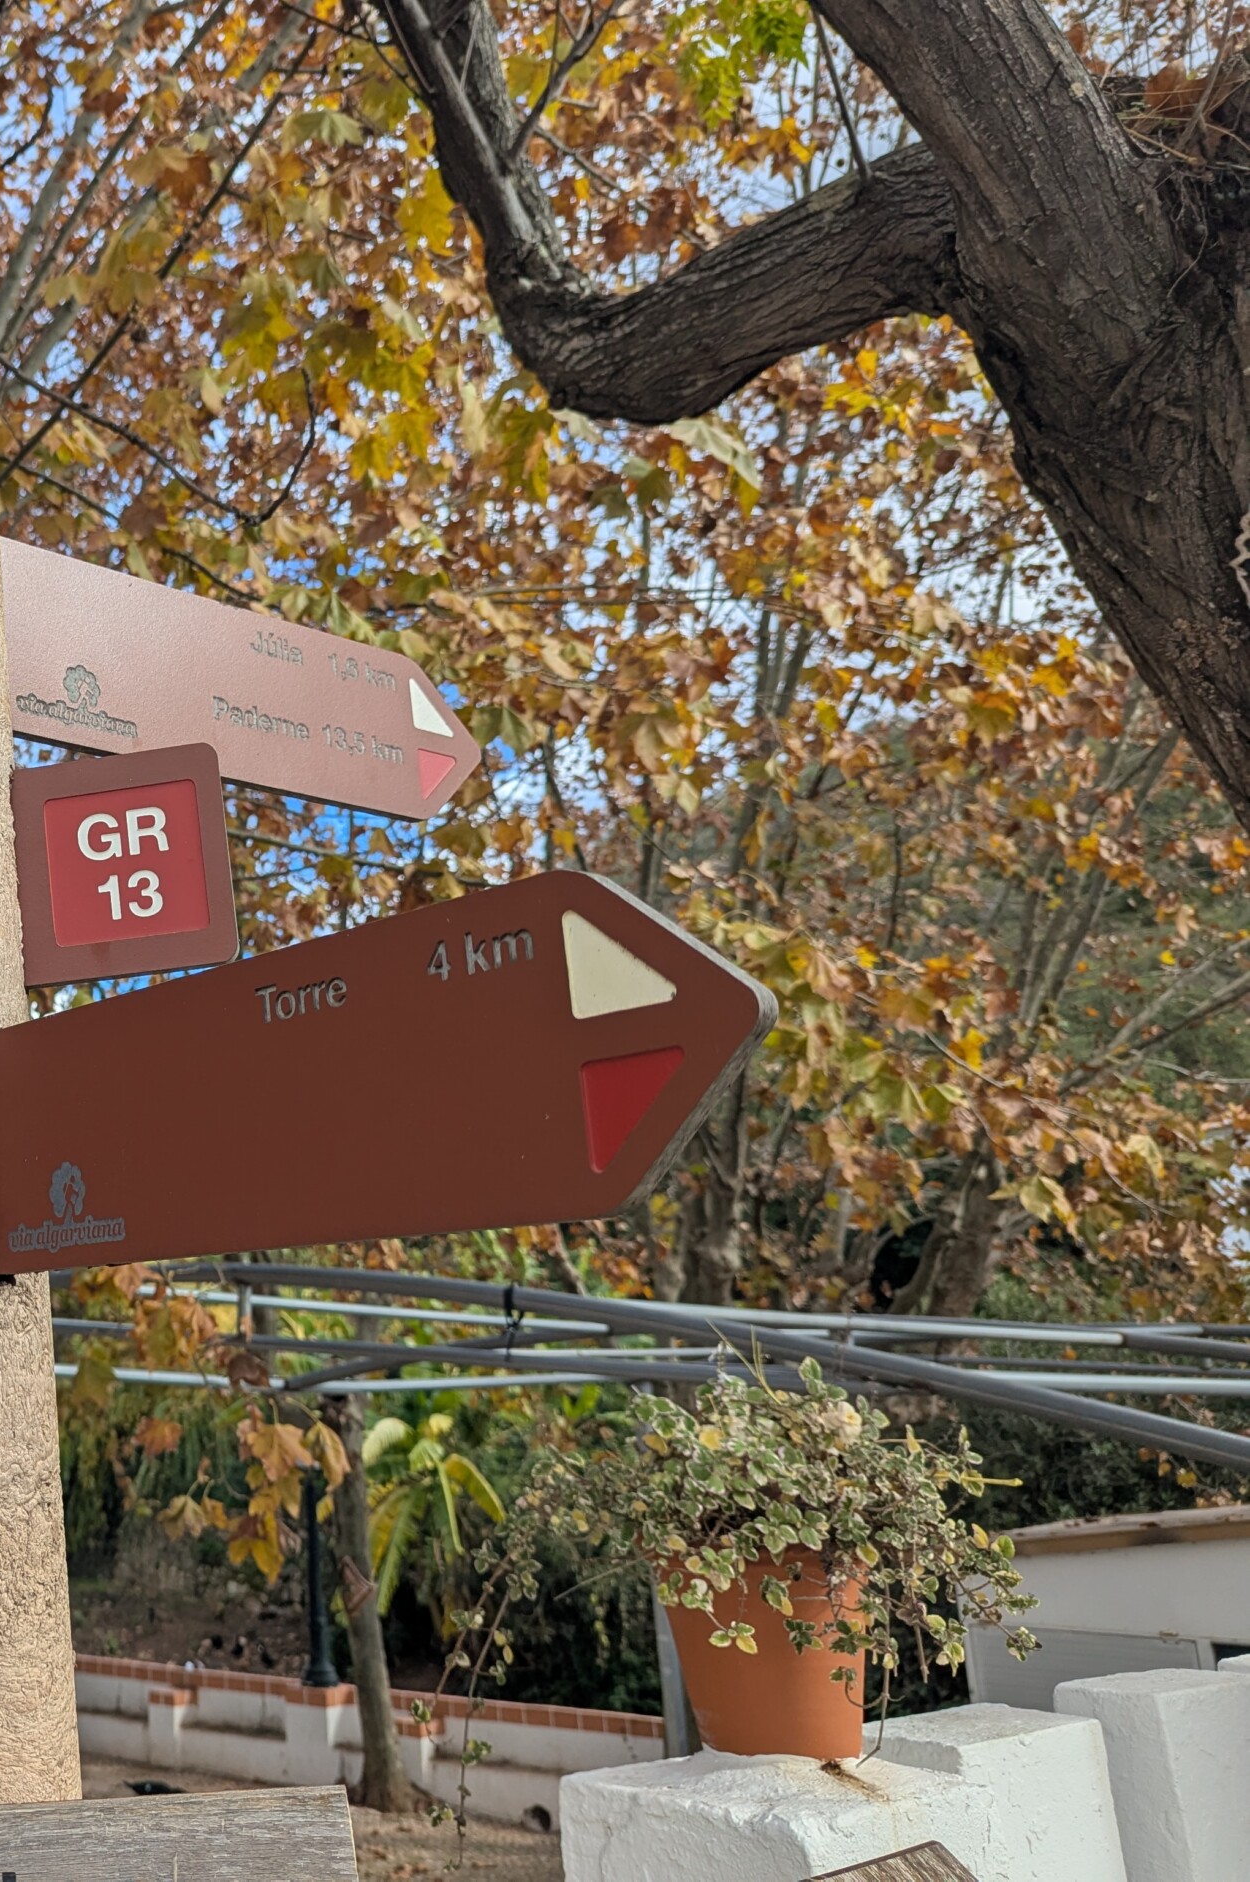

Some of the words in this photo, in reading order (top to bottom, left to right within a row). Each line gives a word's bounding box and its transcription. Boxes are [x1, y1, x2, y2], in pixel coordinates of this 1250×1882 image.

[365, 661, 396, 691] km
[213, 696, 310, 742] Paderne
[322, 723, 366, 756] 13,5
[372, 736, 404, 764] km
[77, 806, 170, 861] GR
[97, 869, 164, 921] 13
[254, 977, 348, 1024] Torre
[427, 940, 451, 982] 4
[464, 928, 534, 976] km
